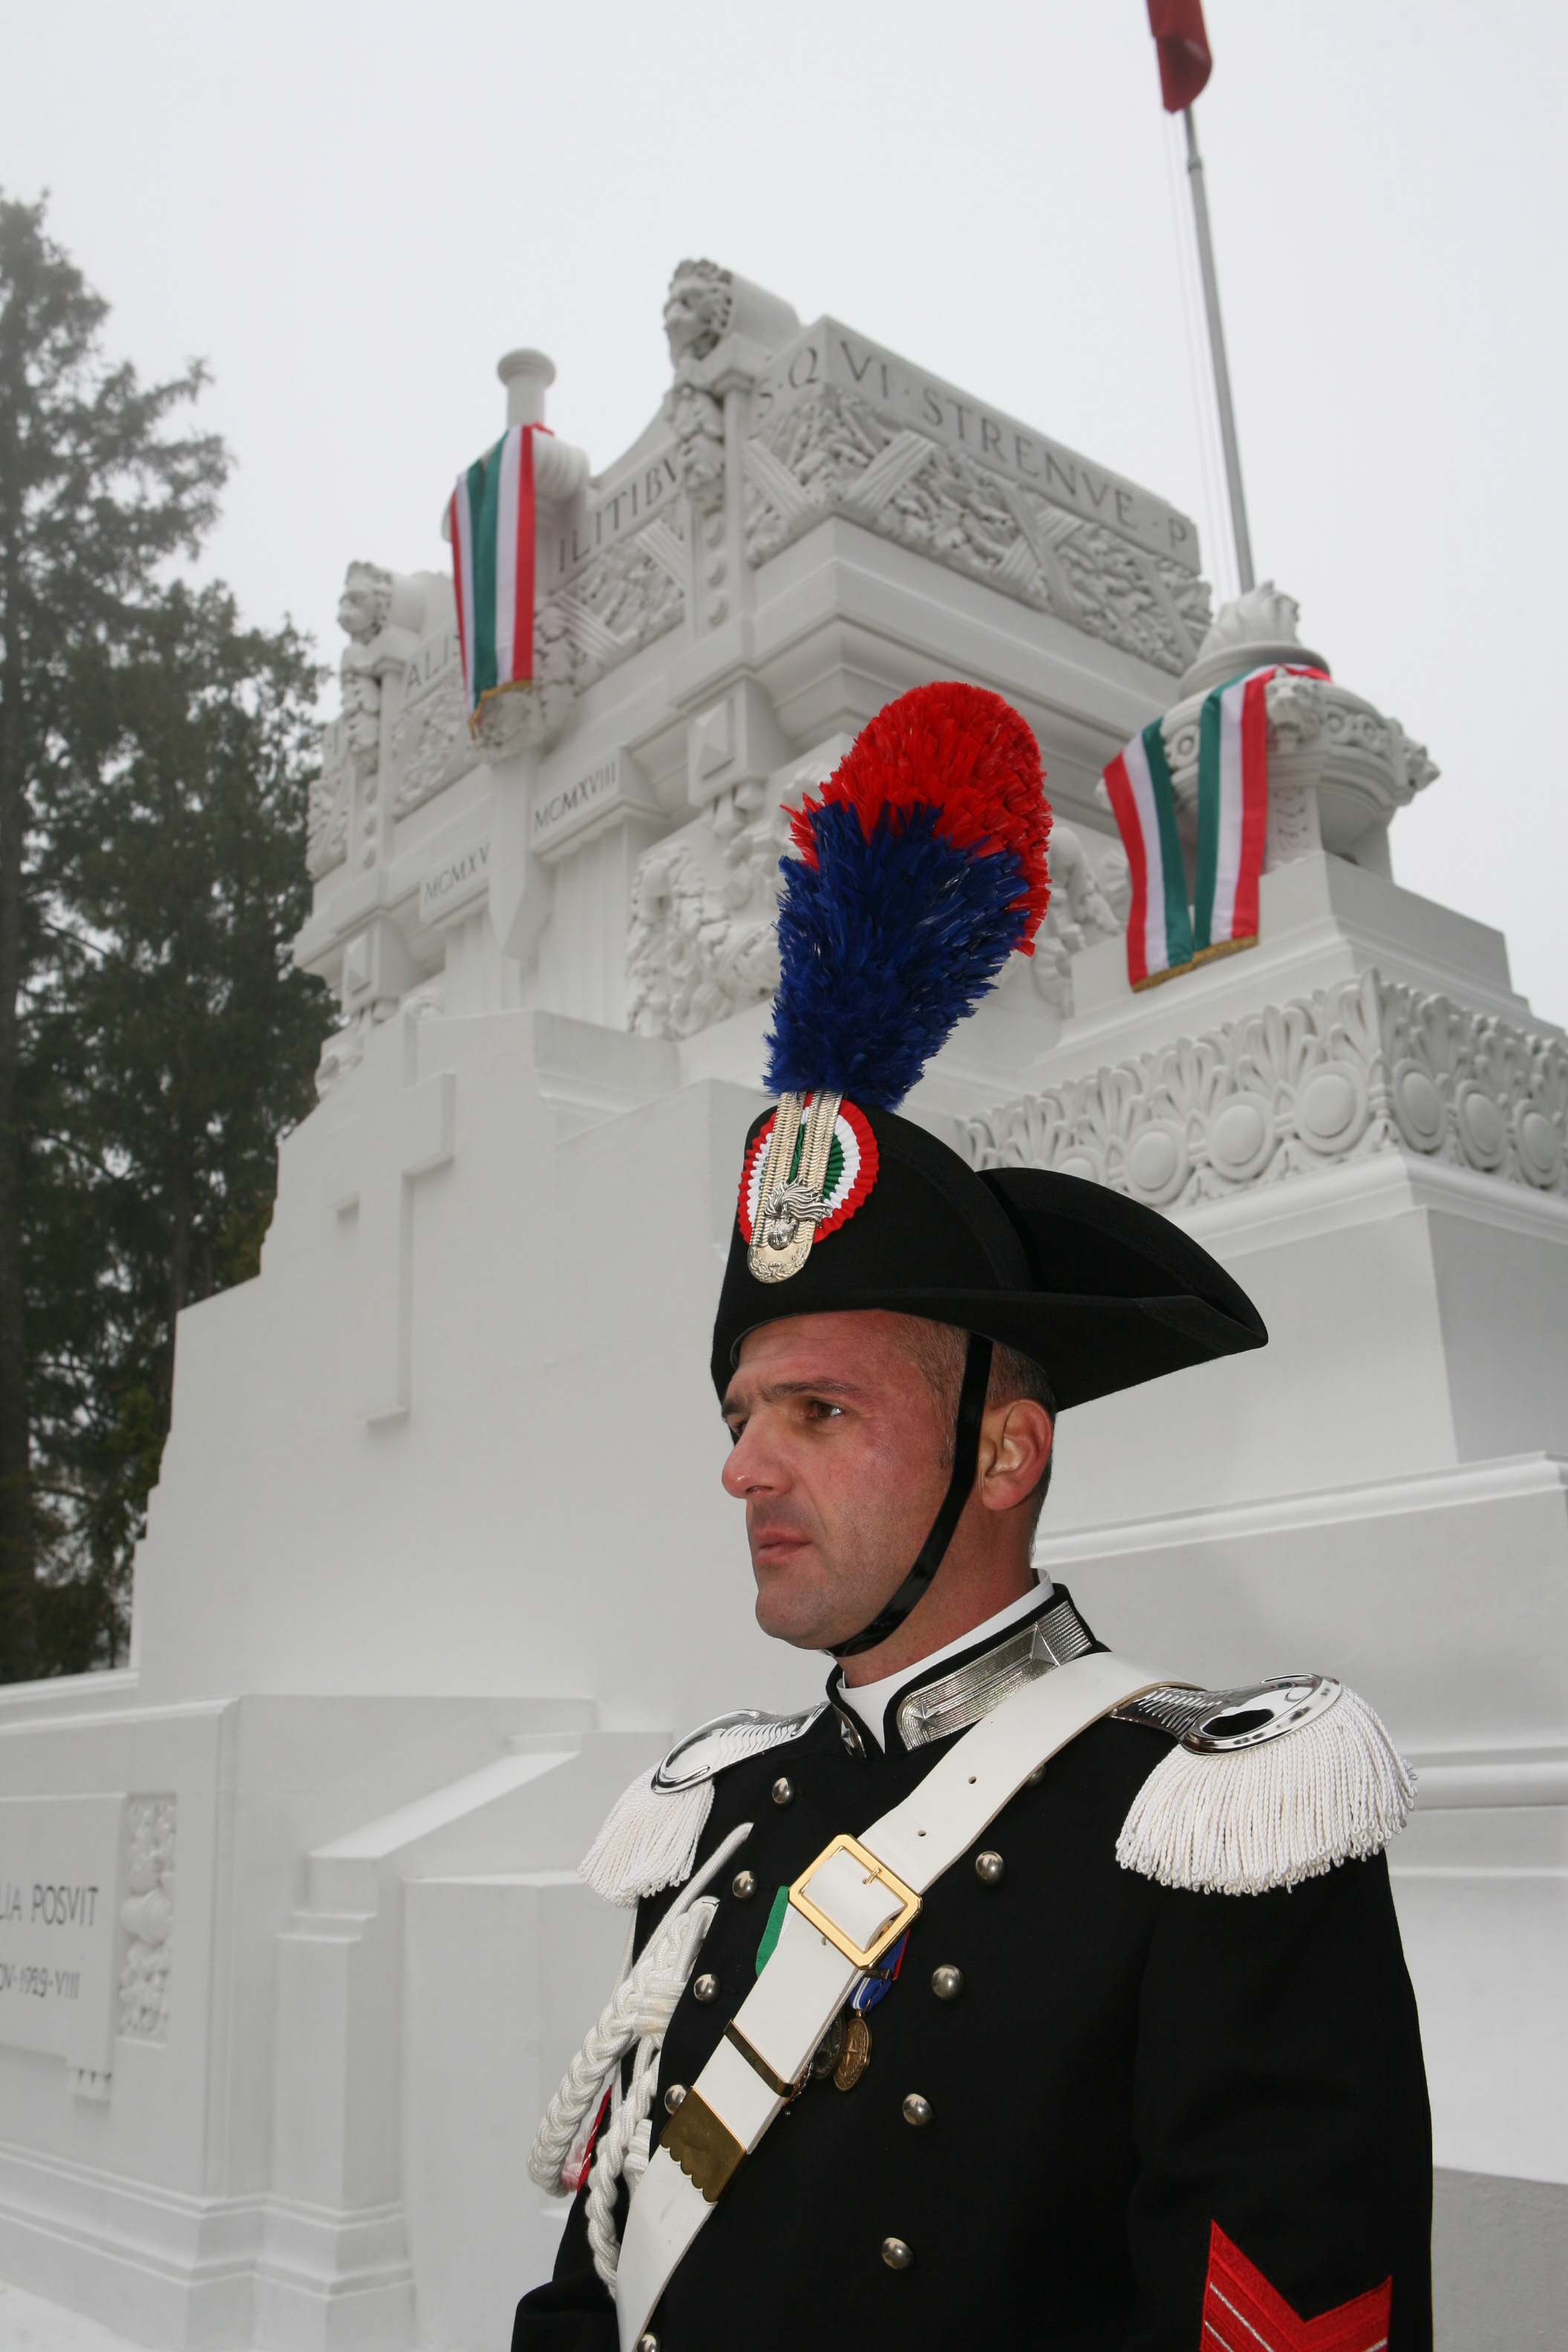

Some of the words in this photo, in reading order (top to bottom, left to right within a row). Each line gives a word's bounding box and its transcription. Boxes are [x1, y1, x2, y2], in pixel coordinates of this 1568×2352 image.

[788, 339, 889, 399] QVI
[922, 387, 1137, 529] STRENVE
[534, 760, 616, 834] MCMXVIII
[31, 1883, 99, 1927] POSVIT
